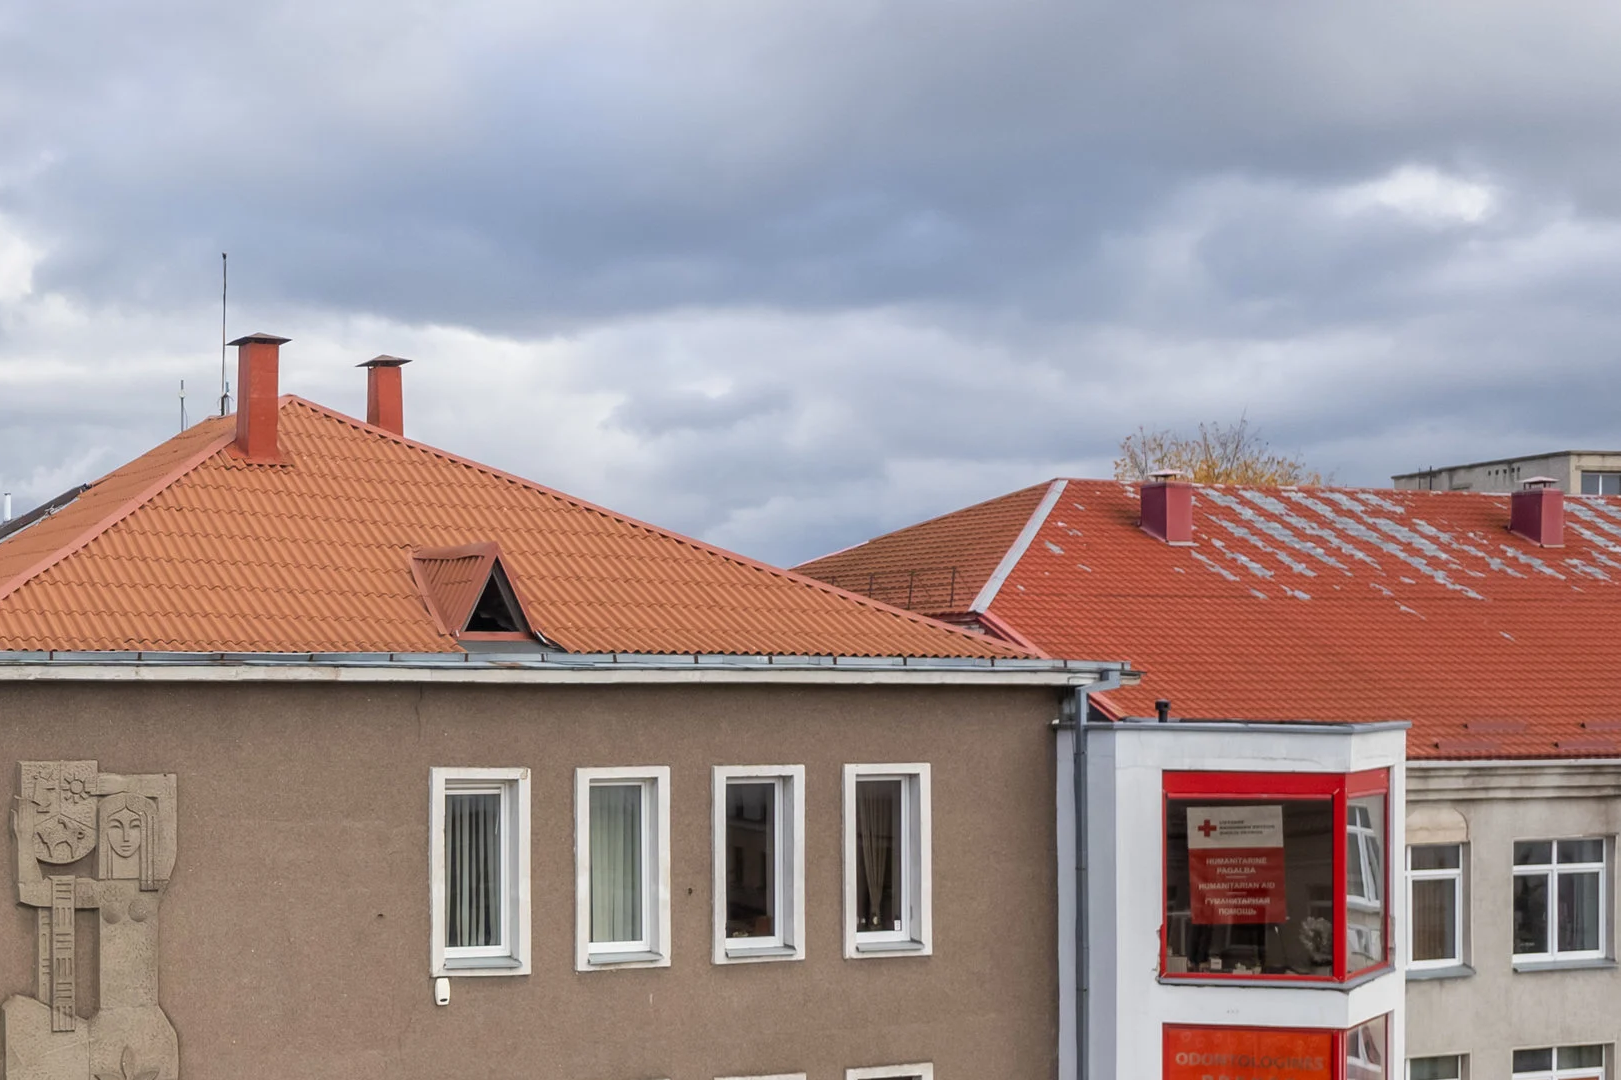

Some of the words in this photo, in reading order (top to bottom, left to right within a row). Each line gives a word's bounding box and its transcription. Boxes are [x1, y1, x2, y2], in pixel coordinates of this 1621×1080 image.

[1216, 867, 1256, 875] PAGALBA
[1199, 881, 1259, 890] HUMANITARIAN
[1261, 881, 1276, 889] AID
